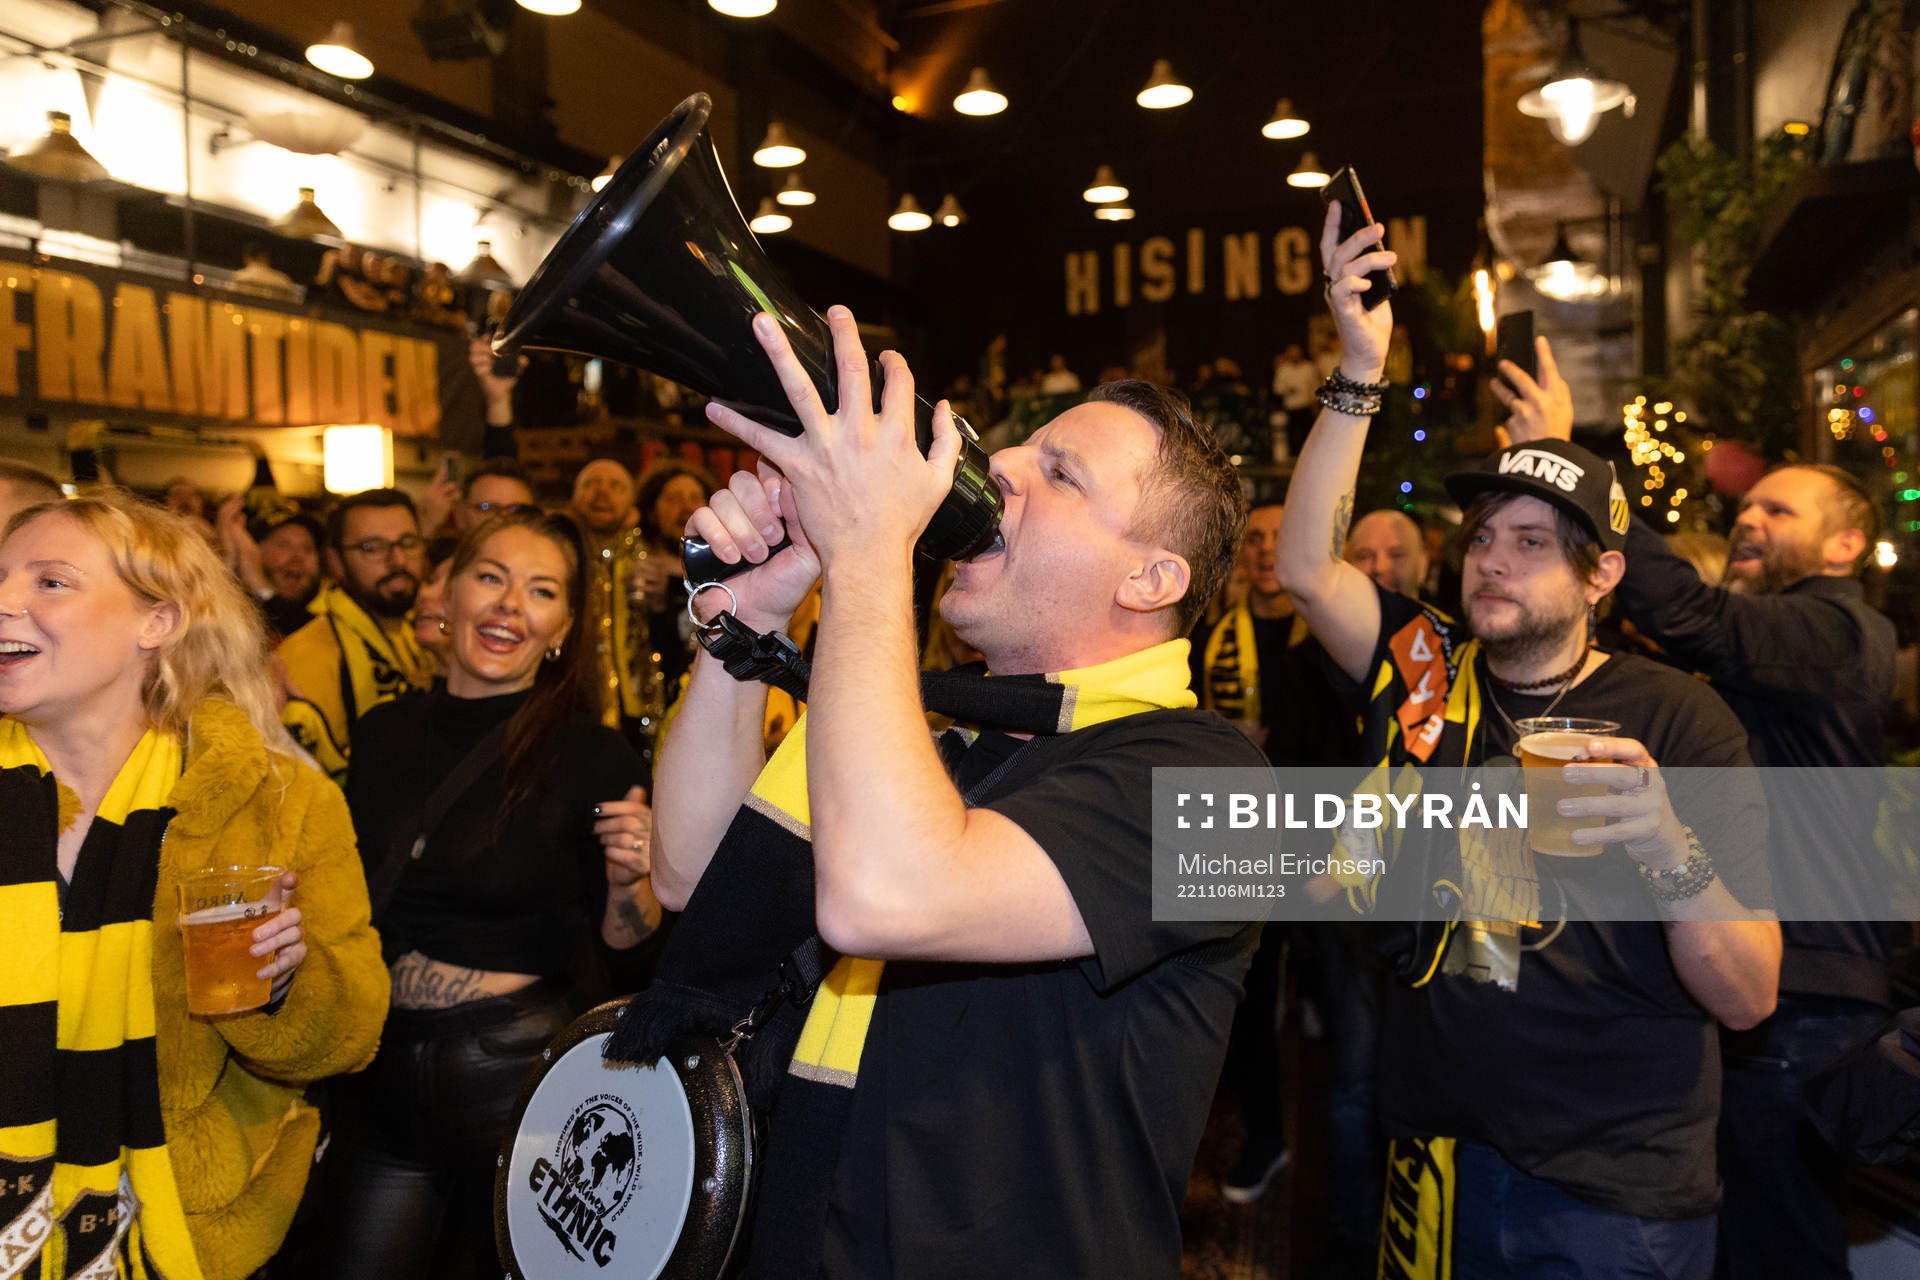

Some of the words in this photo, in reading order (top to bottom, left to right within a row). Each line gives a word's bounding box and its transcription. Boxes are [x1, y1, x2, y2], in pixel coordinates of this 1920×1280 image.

[1065, 216, 1427, 316] HISINGN
[1498, 449, 1585, 492] VANS
[575, 1103, 584, 1114] BY
[585, 1094, 599, 1105] THE
[600, 1094, 623, 1106] VOICES
[624, 1103, 632, 1113] OF
[631, 1112, 640, 1130] THE
[555, 1114, 575, 1157] INSPIRED
[631, 1164, 641, 1190] WILD
[529, 1157, 616, 1268] ETHNIC
[611, 1193, 632, 1222] WORLD
